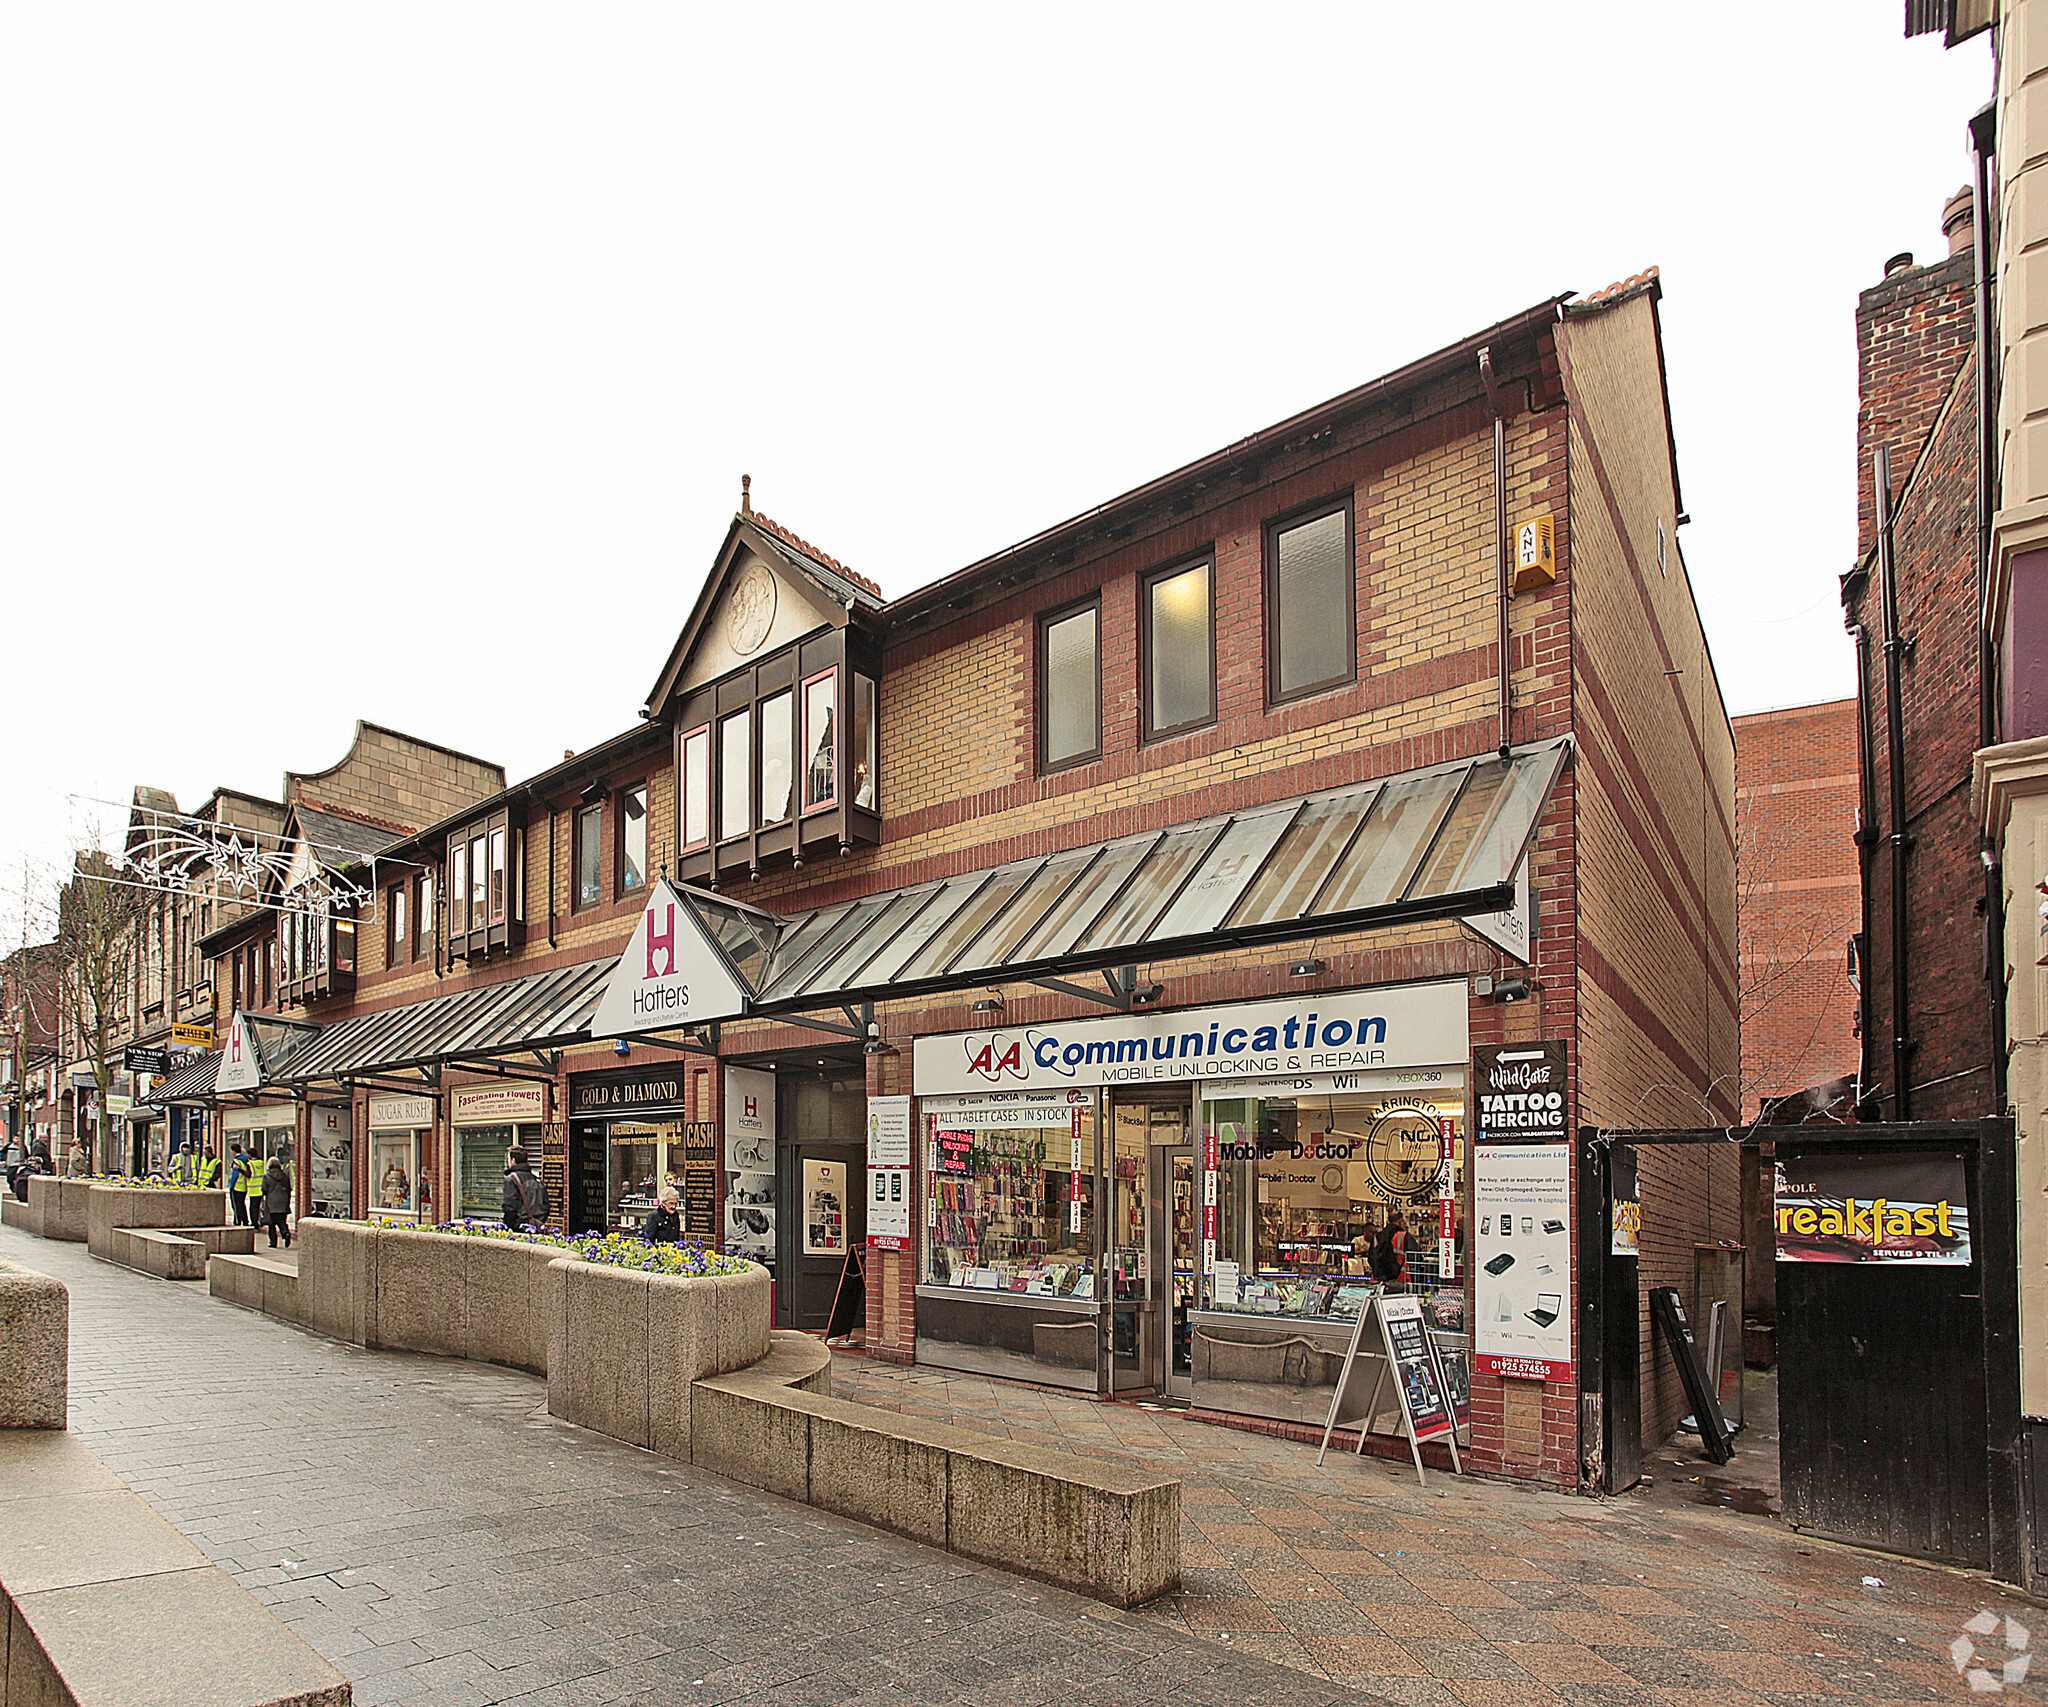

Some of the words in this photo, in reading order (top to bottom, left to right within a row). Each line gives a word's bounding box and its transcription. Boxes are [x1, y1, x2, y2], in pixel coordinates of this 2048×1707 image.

[1522, 526, 1534, 562] ANT
[1190, 873, 1247, 894] Hatters
[633, 984, 689, 1015] Hatters
[127, 1047, 147, 1056] NEWS
[147, 1050, 164, 1058] STOP
[966, 1041, 1022, 1075] AA
[1034, 1013, 1388, 1068] Communication
[1102, 1065, 1163, 1082] MOBILE
[1170, 1057, 1278, 1077] UNLOCKING
[1286, 1056, 1301, 1069] &
[1310, 1050, 1386, 1067] REPAIR
[1258, 1078, 1294, 1087] NINTENDO
[1292, 1078, 1313, 1090] DS
[1332, 1075, 1359, 1089] Wii
[458, 1091, 505, 1109] Fascinating
[507, 1090, 541, 1102] Flowers
[581, 1087, 609, 1106] GOLD
[612, 1085, 620, 1104] &
[624, 1080, 678, 1103] DIAMOND
[989, 1093, 1020, 1103] NOKIA
[1025, 1093, 1057, 1103] Panasonic
[1480, 1092, 1563, 1113] TATTOO
[377, 1103, 402, 1121] SUGAR
[406, 1101, 427, 1119] RUSH
[939, 1113, 954, 1124] ALL
[957, 1112, 988, 1123] TABLET
[988, 1110, 1018, 1122] CASES
[1024, 1110, 1035, 1121] IN
[1036, 1108, 1068, 1121] STOCK
[1364, 1096, 1444, 1127] WARRINGTON
[1481, 1111, 1563, 1128] PIERCING
[739, 1117, 763, 1128] Hatters
[543, 1124, 564, 1145] CASH
[686, 1123, 714, 1149] CASH
[952, 1150, 959, 1161] &
[1220, 1141, 1274, 1161] Mobile
[1290, 1141, 1357, 1160] Doctor
[944, 1159, 966, 1171] REPAIR
[1288, 1174, 1316, 1183] Doctor
[1364, 1176, 1403, 1208] REPAIR
[1406, 1176, 1448, 1208] CENTRE
[1784, 1183, 1817, 1194] POLE
[1776, 1198, 1954, 1247] reakfast
[1872, 1249, 1913, 1258] SERVED
[1915, 1250, 1923, 1258] 9
[1924, 1250, 1943, 1259] TIL
[1945, 1251, 1959, 1259] 12
[1491, 1360, 1518, 1371] 01925
[1518, 1363, 1551, 1375] 574555
